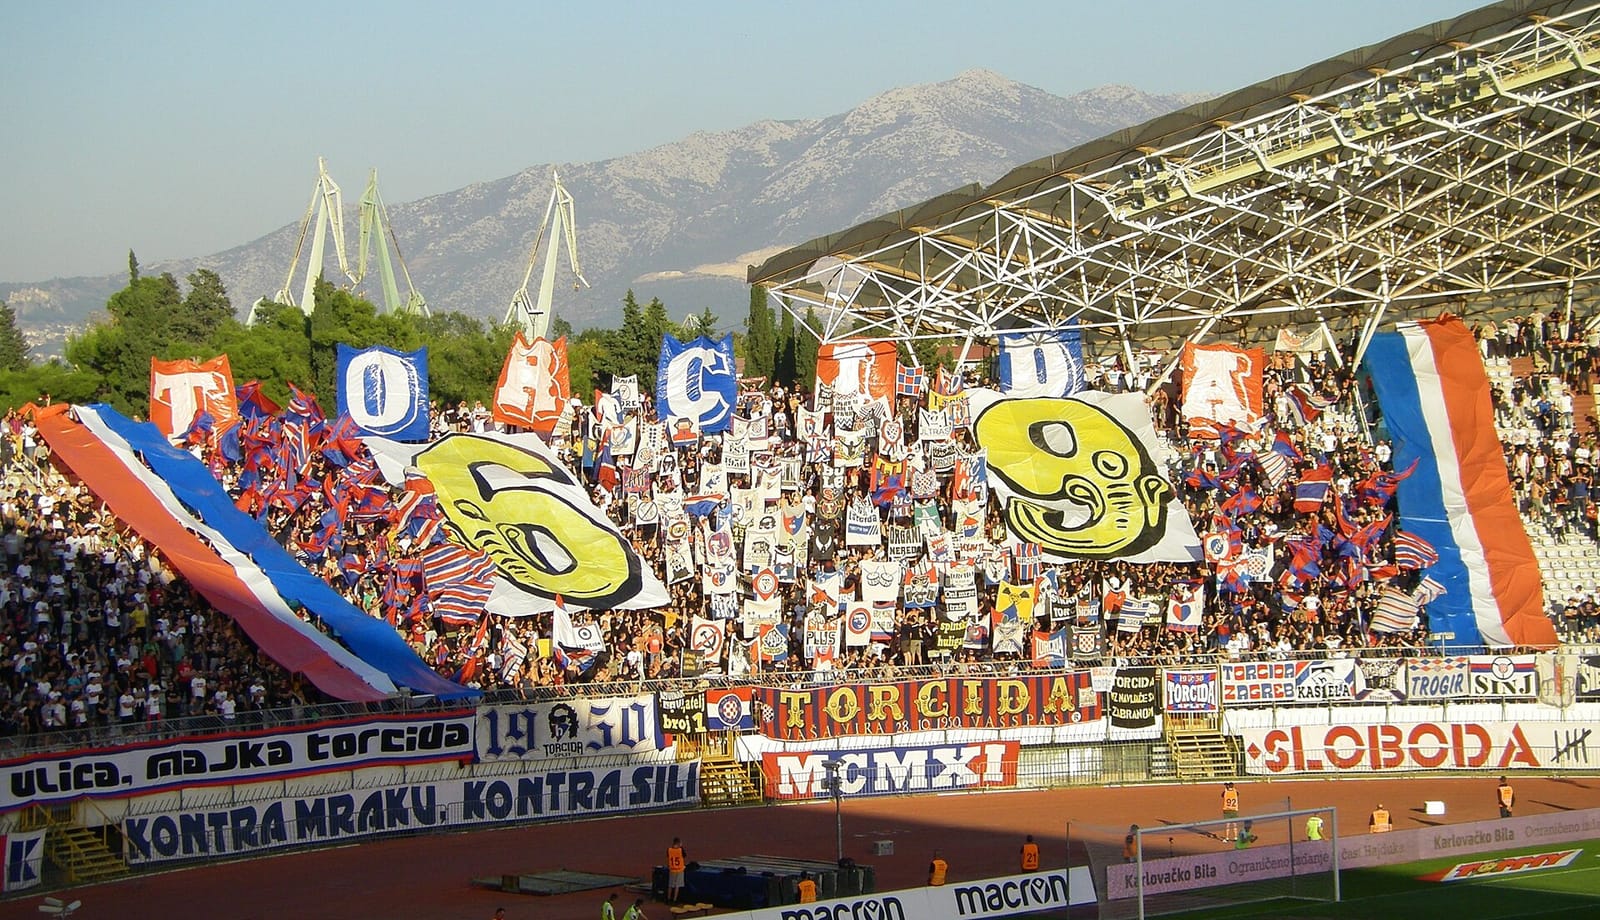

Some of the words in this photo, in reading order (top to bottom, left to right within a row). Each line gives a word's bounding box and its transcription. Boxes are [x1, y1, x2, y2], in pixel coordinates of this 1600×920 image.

[1223, 663, 1295, 681] TORCIDA
[1167, 679, 1215, 704] TORCIDA
[1224, 682, 1295, 700] ZAGREB
[1412, 673, 1464, 696] TROGIR
[1475, 674, 1532, 695] SINJ
[780, 677, 1076, 729] TORCIDA
[663, 715, 690, 733] broj
[543, 741, 583, 757] TORCIDA
[1264, 722, 1541, 772] SLOBODA
[777, 744, 1007, 795] MCMXI
[126, 800, 289, 860] KONTRA
[463, 769, 621, 820] KONTRA
[629, 761, 699, 806] SILI
[1225, 798, 1237, 808] 92
[670, 856, 681, 867] 15
[1026, 853, 1037, 864] 21
[1194, 864, 1217, 880] Bila
[1229, 857, 1290, 876] Ograničeno
[954, 874, 1067, 916] macron
